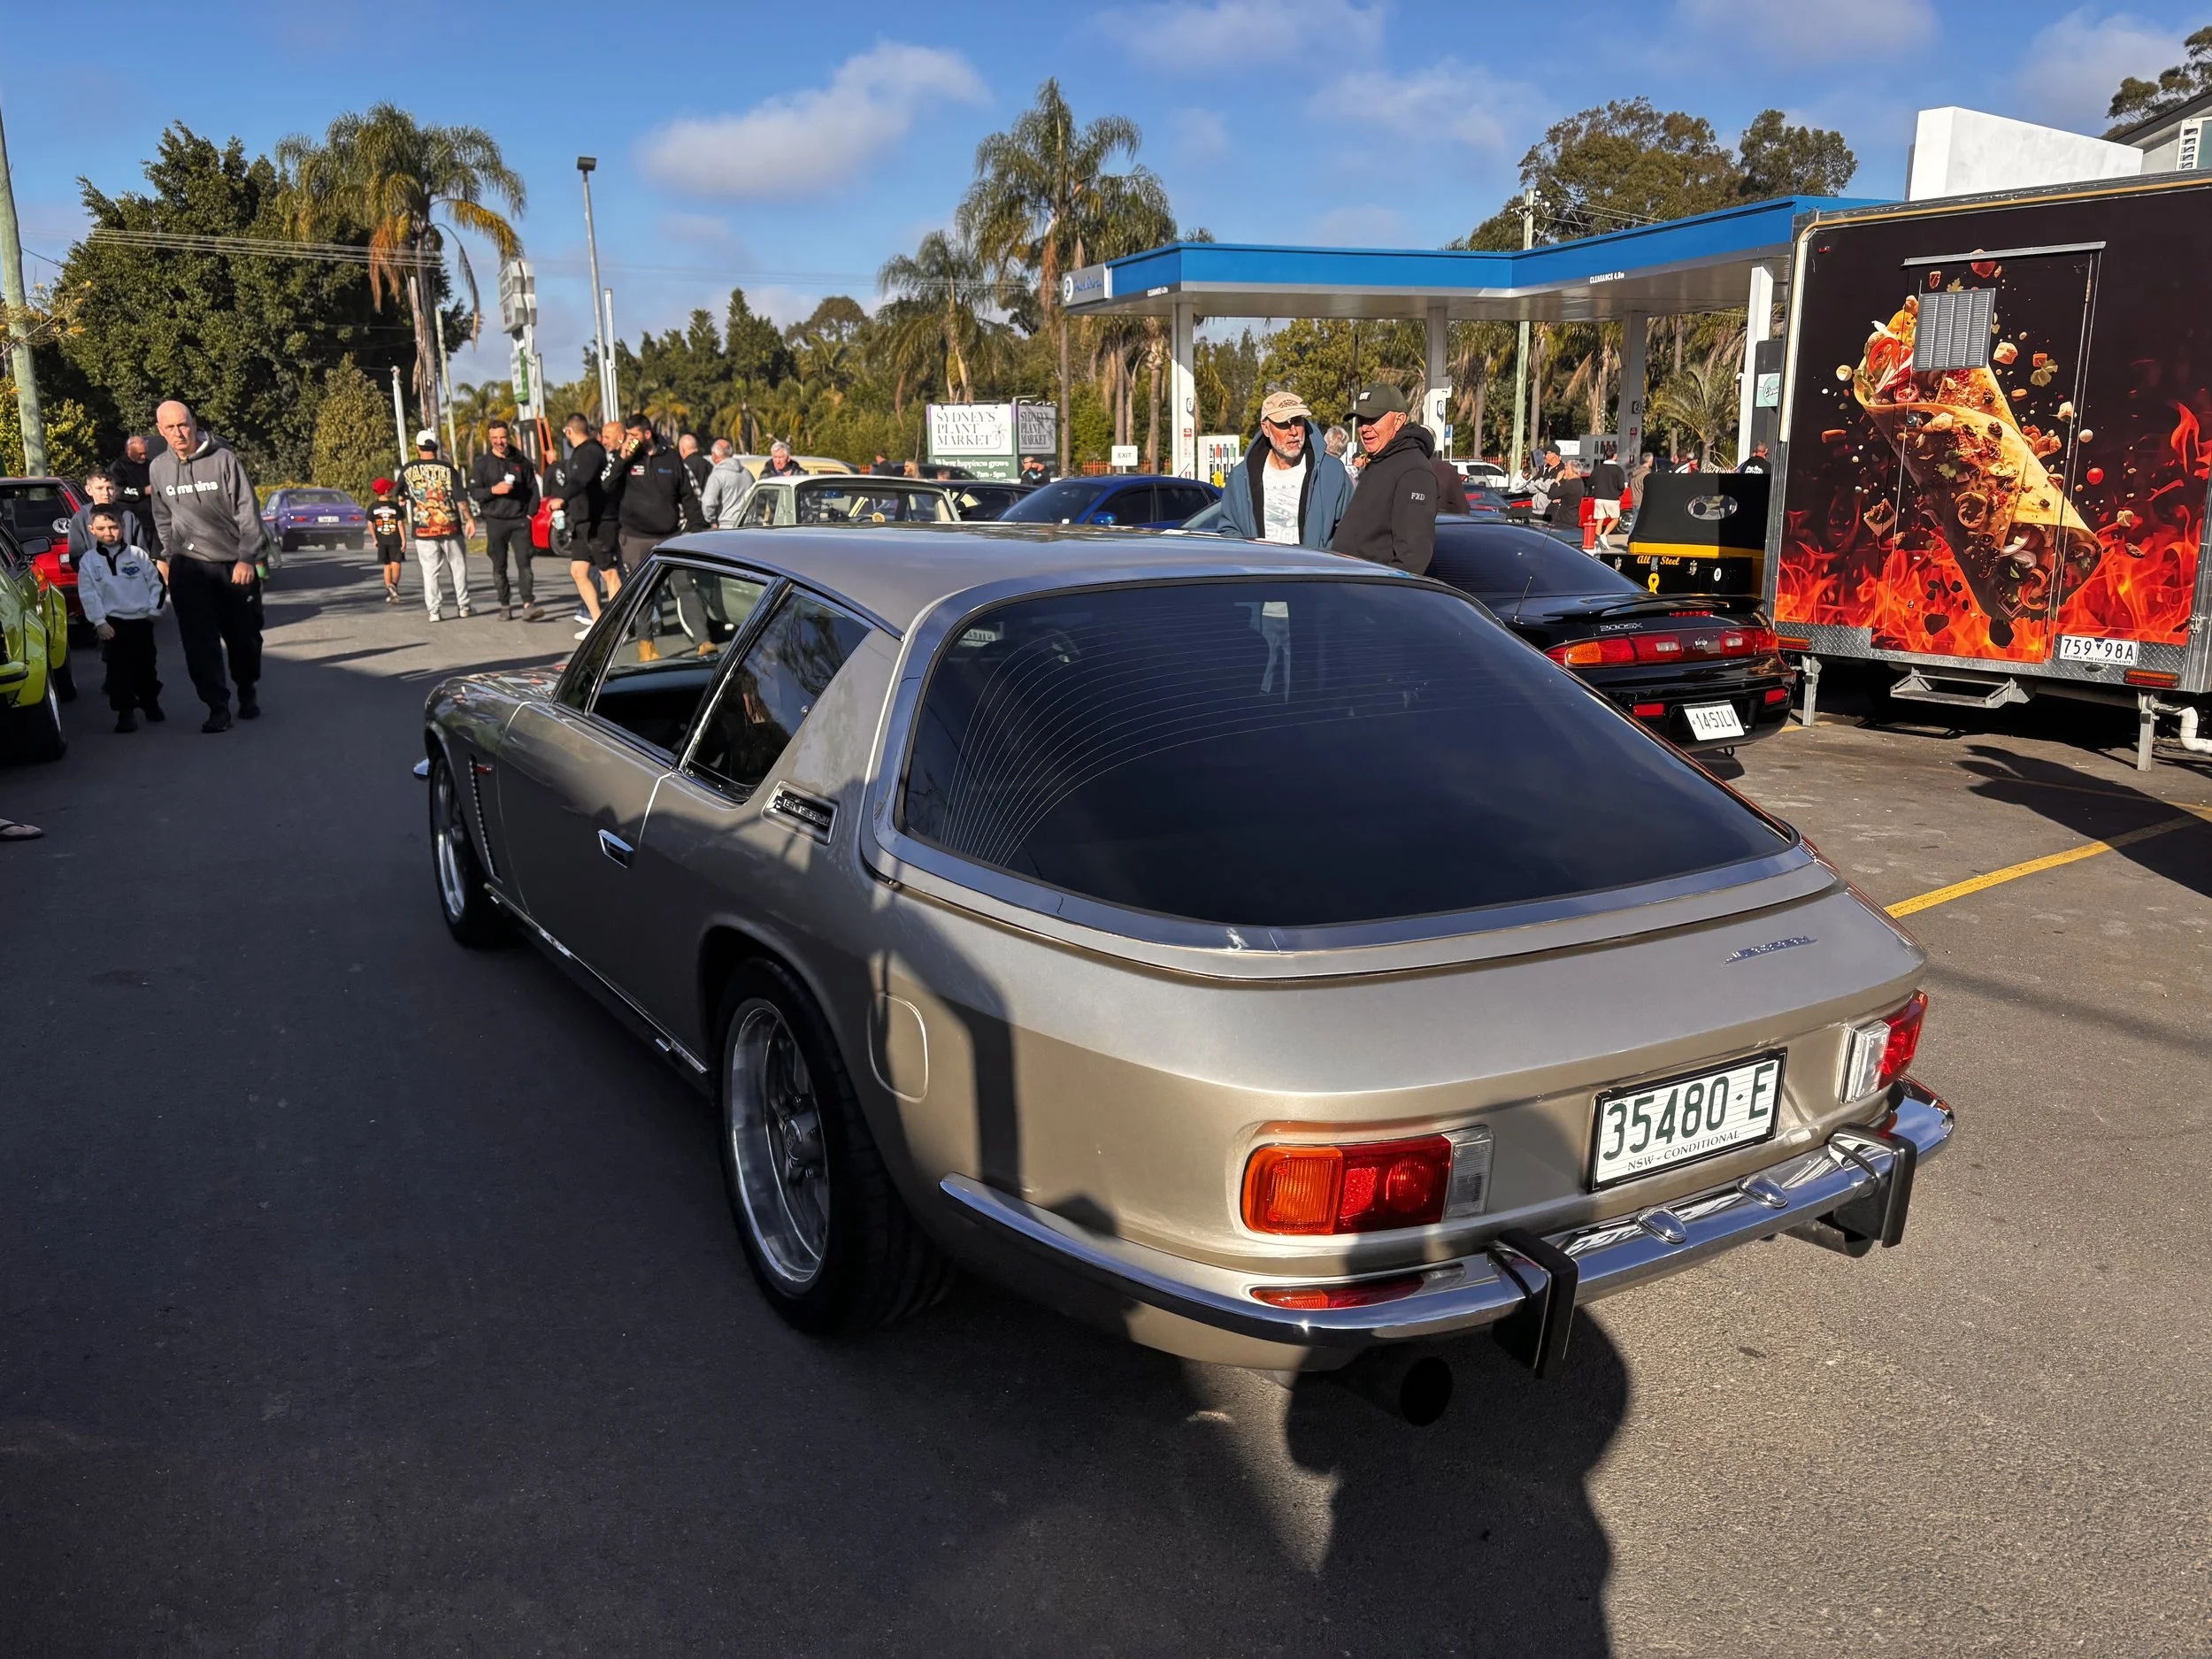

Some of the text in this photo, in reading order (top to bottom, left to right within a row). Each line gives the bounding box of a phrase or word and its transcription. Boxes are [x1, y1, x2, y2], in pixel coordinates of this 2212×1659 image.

[936, 411, 995, 422] SYDNEY'S
[937, 424, 979, 434] PLANT
[1021, 422, 1041, 434] PLANT
[937, 434, 992, 445] MARKET
[1021, 434, 1047, 445] MARKET
[1410, 492, 1425, 501] FXD
[1637, 555, 1680, 565] All Steel
[2064, 638, 2133, 660] 759 98A
[1627, 1155, 1654, 1171] NSW
[1663, 1130, 1740, 1160] CONDITIONAL
